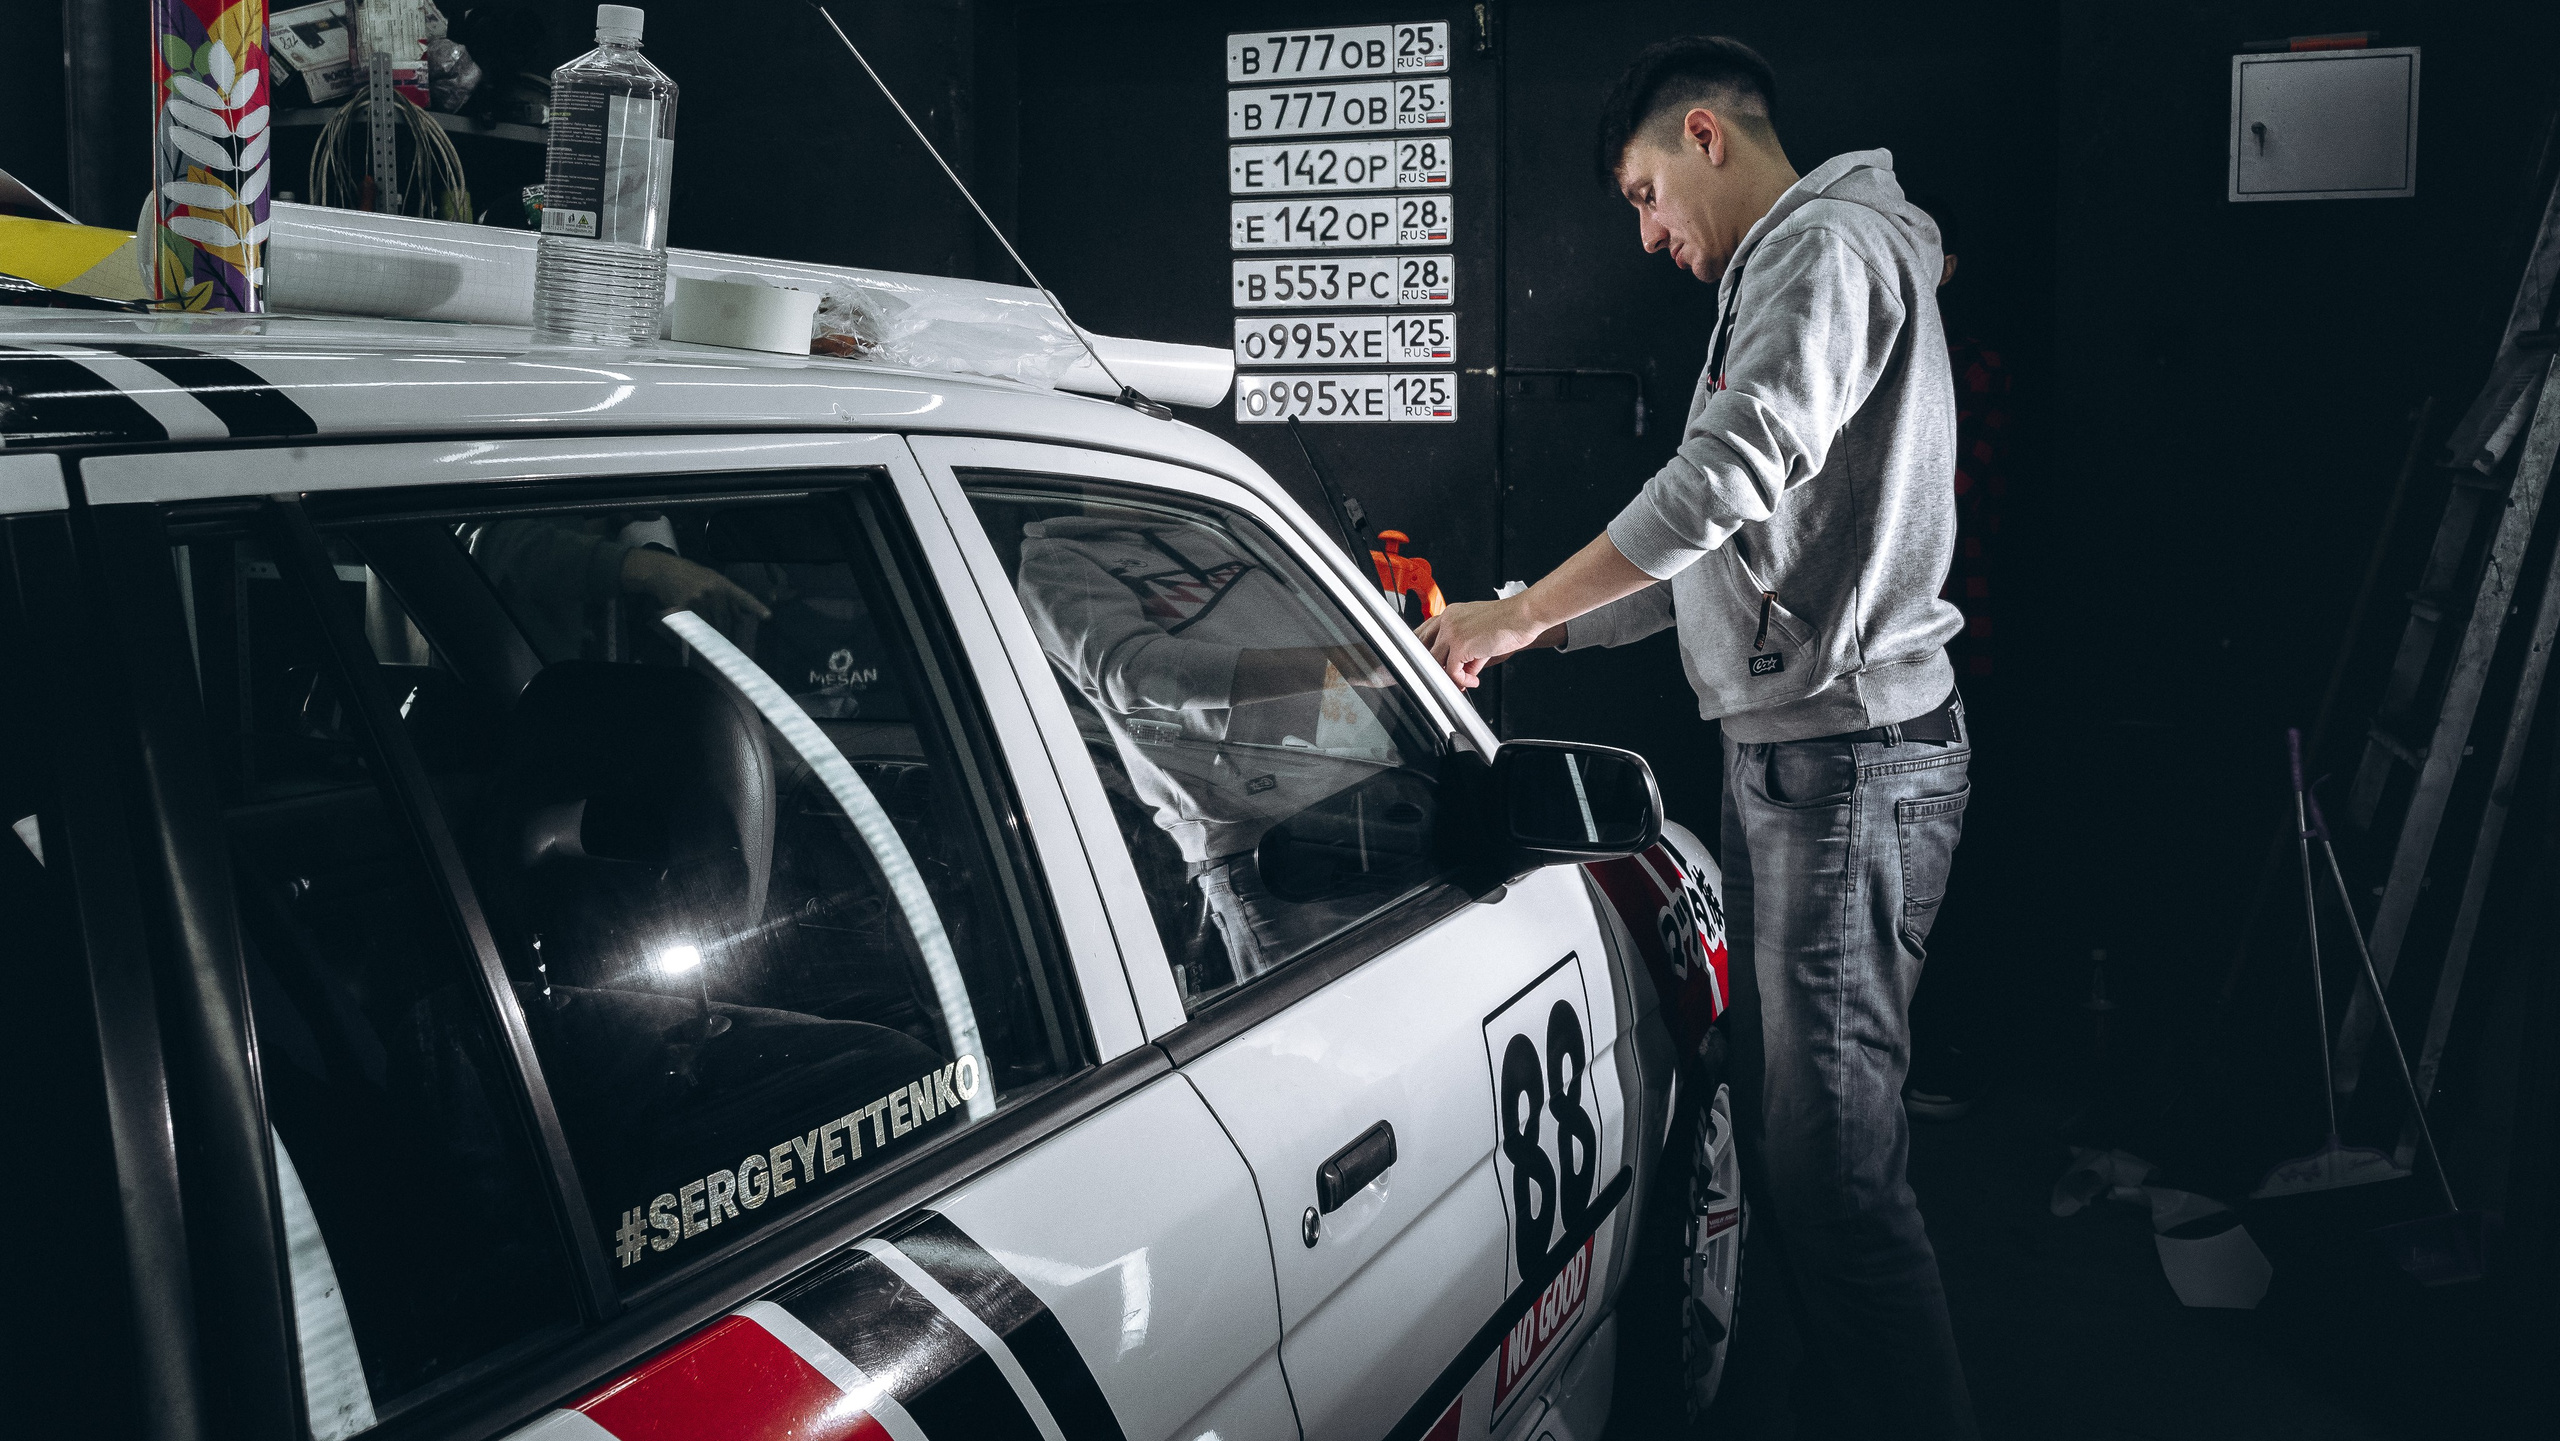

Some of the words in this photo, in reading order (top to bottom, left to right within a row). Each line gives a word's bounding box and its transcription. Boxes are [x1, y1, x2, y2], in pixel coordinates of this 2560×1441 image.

[1399, 26, 1435, 56] 25
[1397, 57, 1424, 68] RUS
[1400, 84, 1436, 112] 25
[1398, 113, 1425, 125] RUS
[1402, 143, 1437, 171] 28
[1399, 172, 1426, 184] RUS
[1402, 200, 1438, 229] 28
[1400, 229, 1427, 241] RUS
[1403, 260, 1439, 289] 28
[1401, 288, 1428, 300] RUS
[1392, 318, 1445, 347] 125
[1403, 347, 1430, 358] RUS
[1393, 378, 1446, 405] 125
[1405, 405, 1432, 417] RUS
[1500, 998, 1598, 1282] 88
[615, 1054, 980, 1269] #SERGEYETTENKO
[1506, 1304, 1535, 1388] NO
[1538, 1244, 1587, 1343] GOOD
